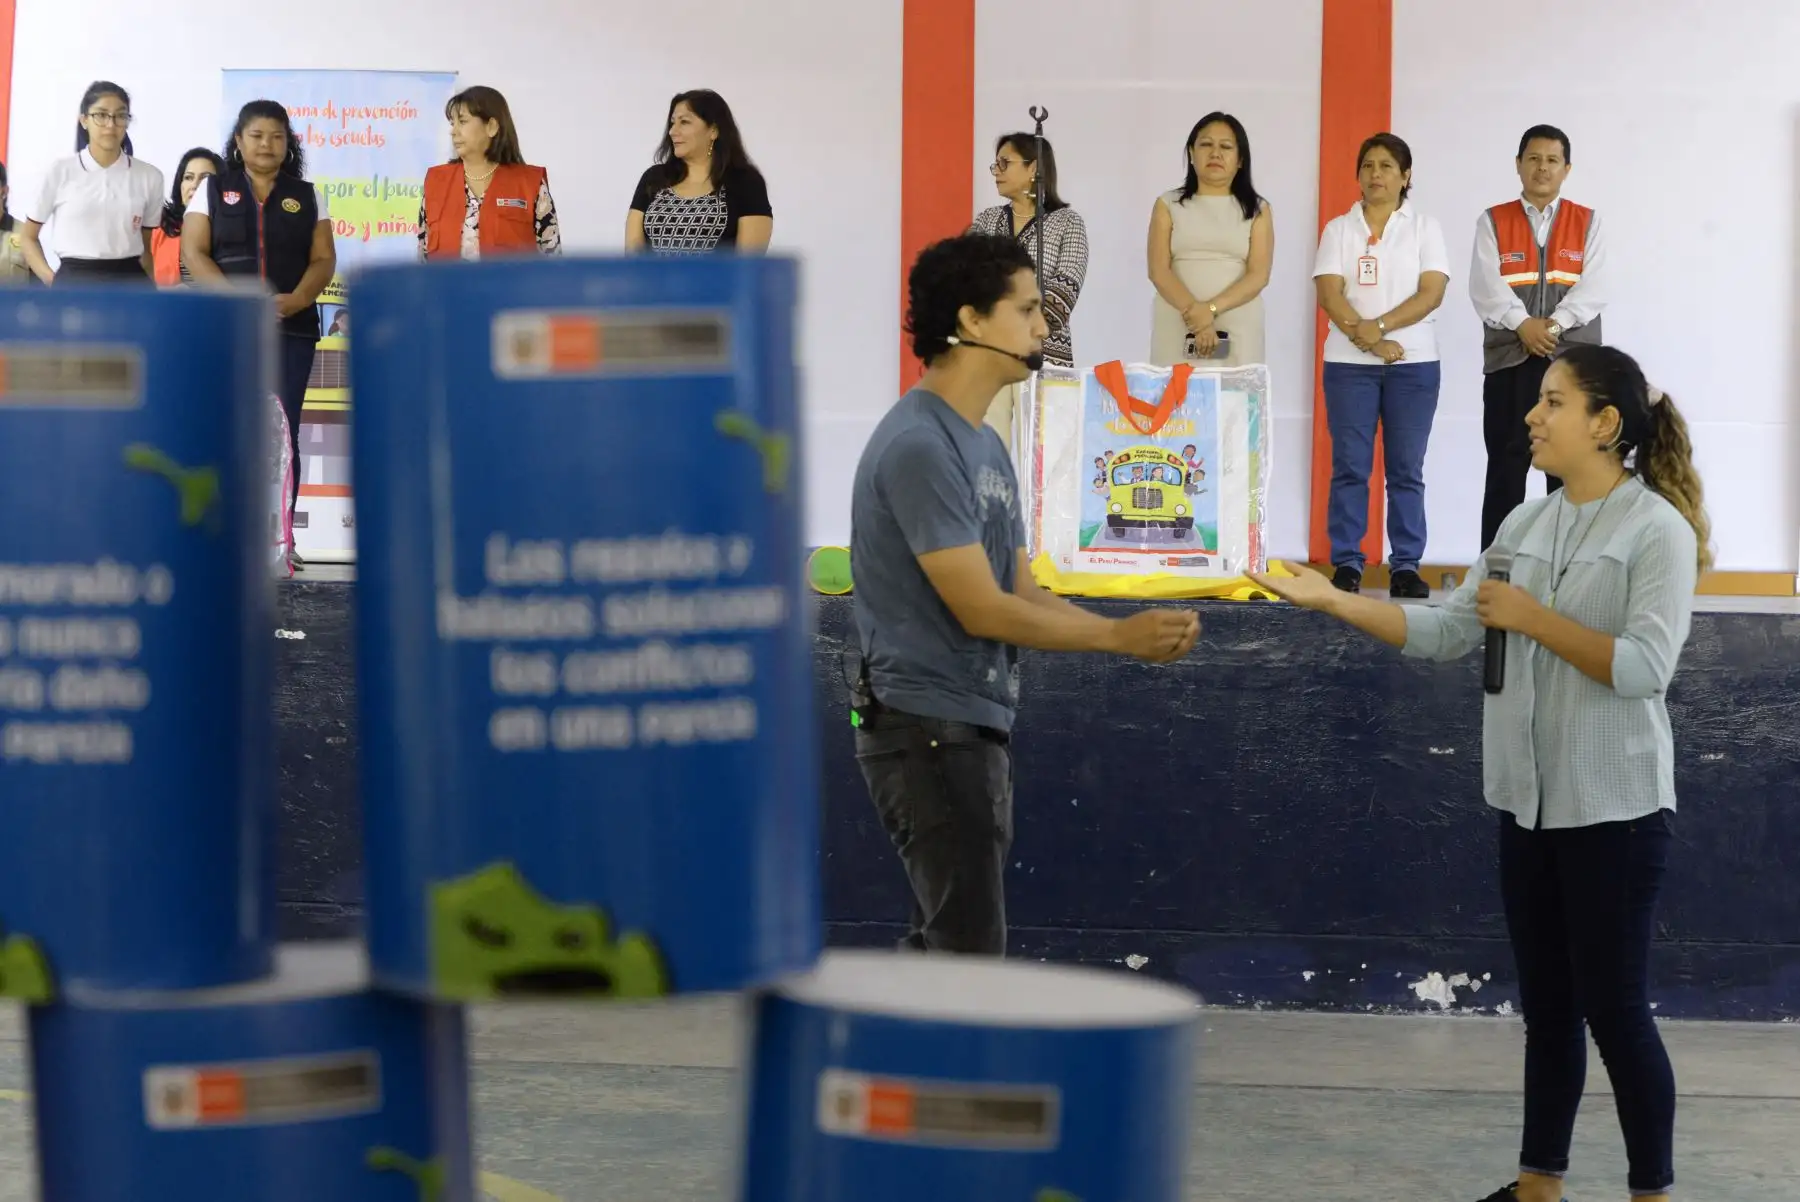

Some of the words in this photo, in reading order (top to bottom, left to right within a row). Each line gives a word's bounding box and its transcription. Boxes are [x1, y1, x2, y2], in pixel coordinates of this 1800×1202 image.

[322, 99, 337, 119] de
[342, 100, 417, 129] prevención
[307, 123, 325, 147] las
[329, 124, 385, 147] escuelas
[324, 182, 356, 209] por
[363, 173, 378, 198] el
[383, 176, 424, 201] bue
[362, 221, 370, 242] y
[377, 213, 420, 236] niña
